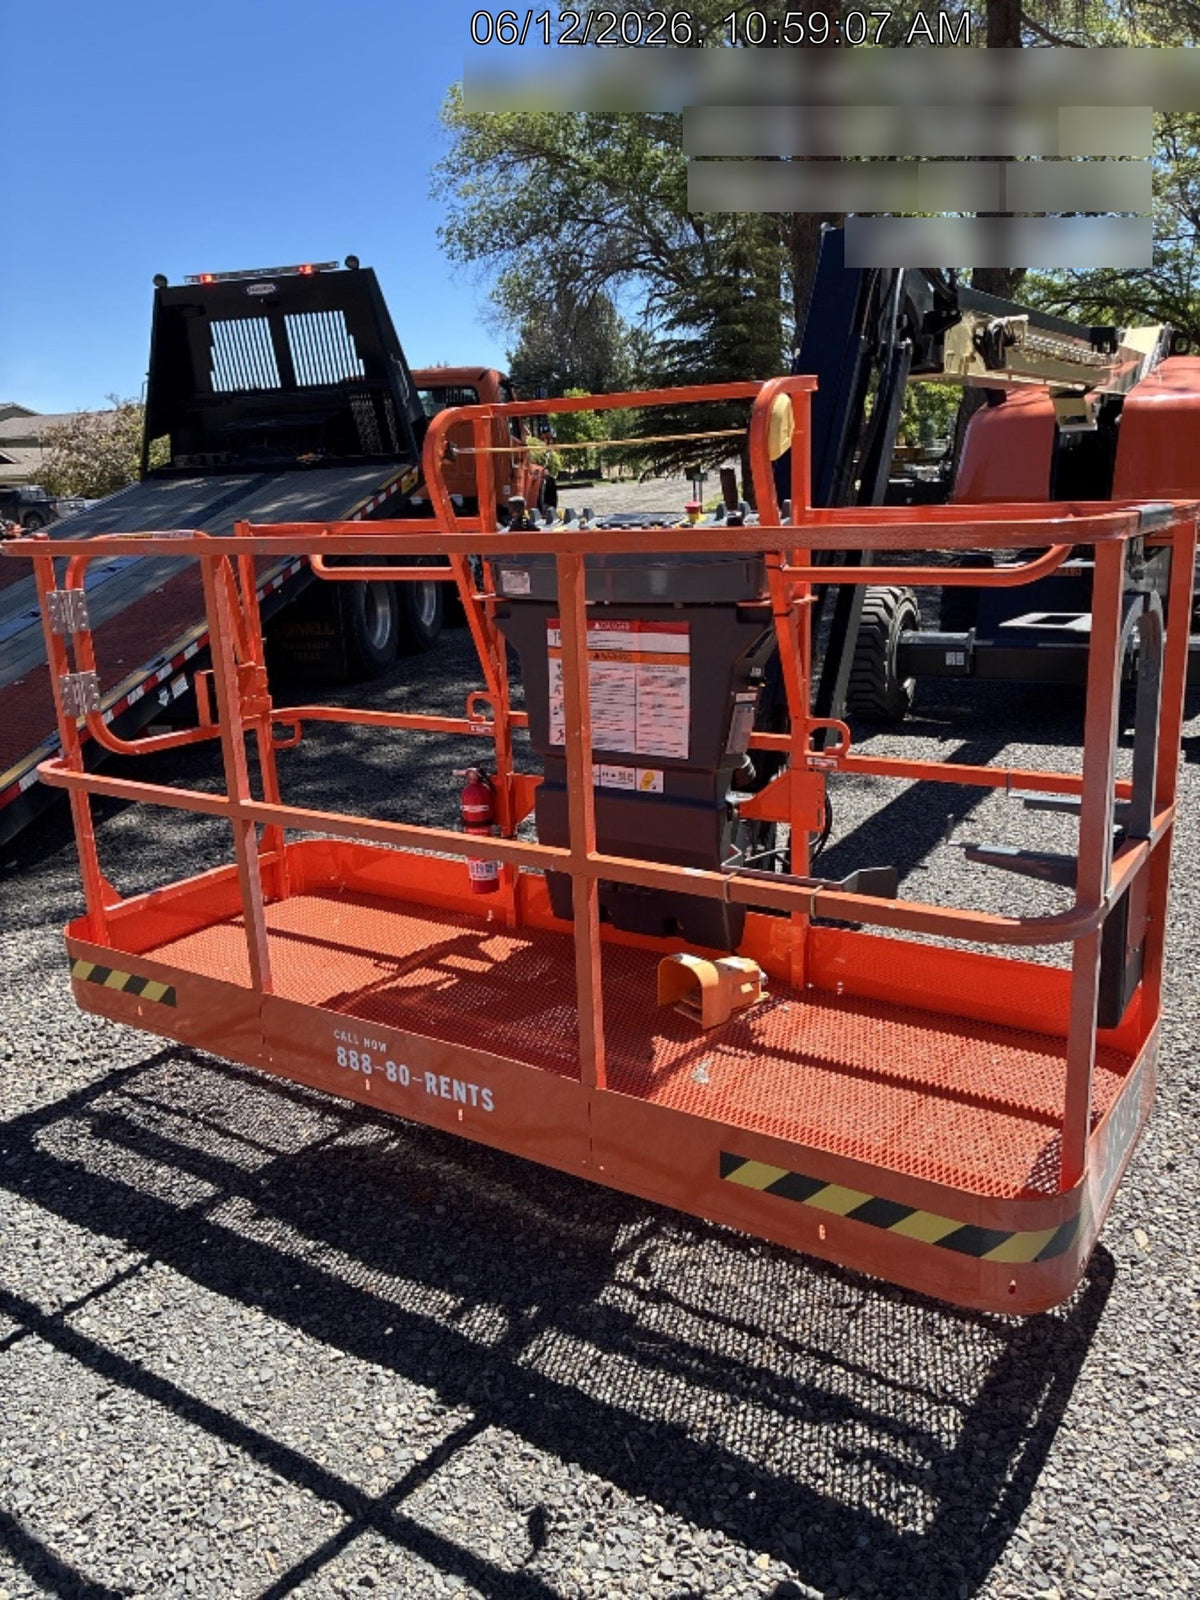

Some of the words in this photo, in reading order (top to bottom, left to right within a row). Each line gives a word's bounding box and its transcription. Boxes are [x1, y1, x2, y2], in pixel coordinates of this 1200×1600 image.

[333, 1029, 359, 1045] CALL
[363, 1037, 387, 1053] NOW
[336, 1046, 495, 1112] 888-80-RENTS
